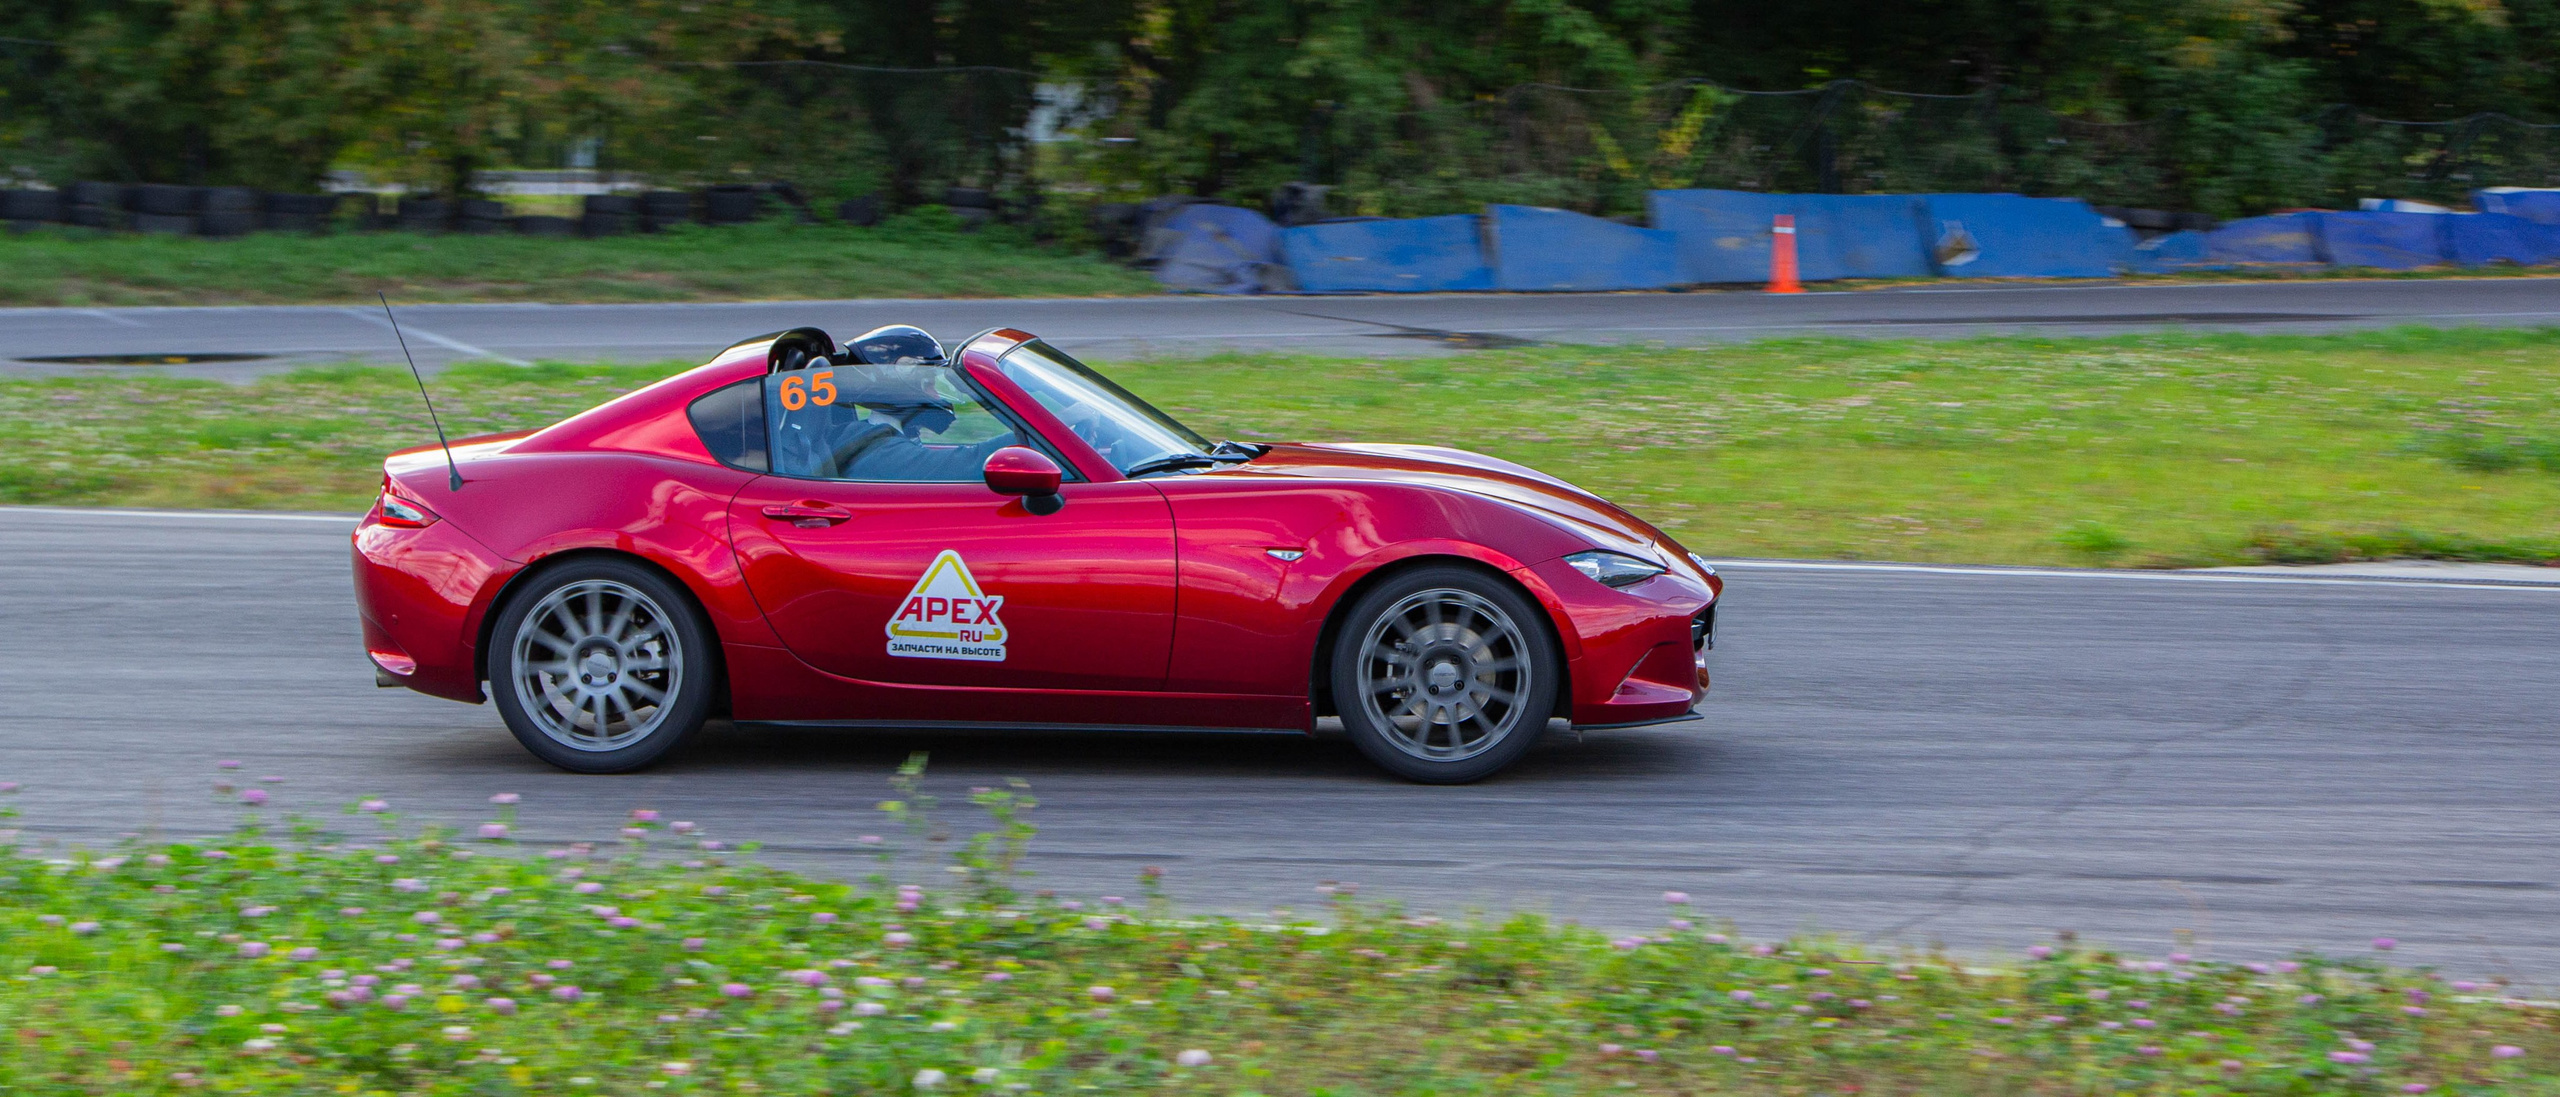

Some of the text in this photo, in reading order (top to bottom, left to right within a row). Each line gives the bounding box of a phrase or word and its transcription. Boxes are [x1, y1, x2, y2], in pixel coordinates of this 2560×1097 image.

[780, 371, 837, 411] 65
[896, 596, 998, 625] APEX
[960, 630, 983, 643] RU
[892, 643, 1001, 657] ЗАПЧАСТИ НА ВЫСОТЕ
